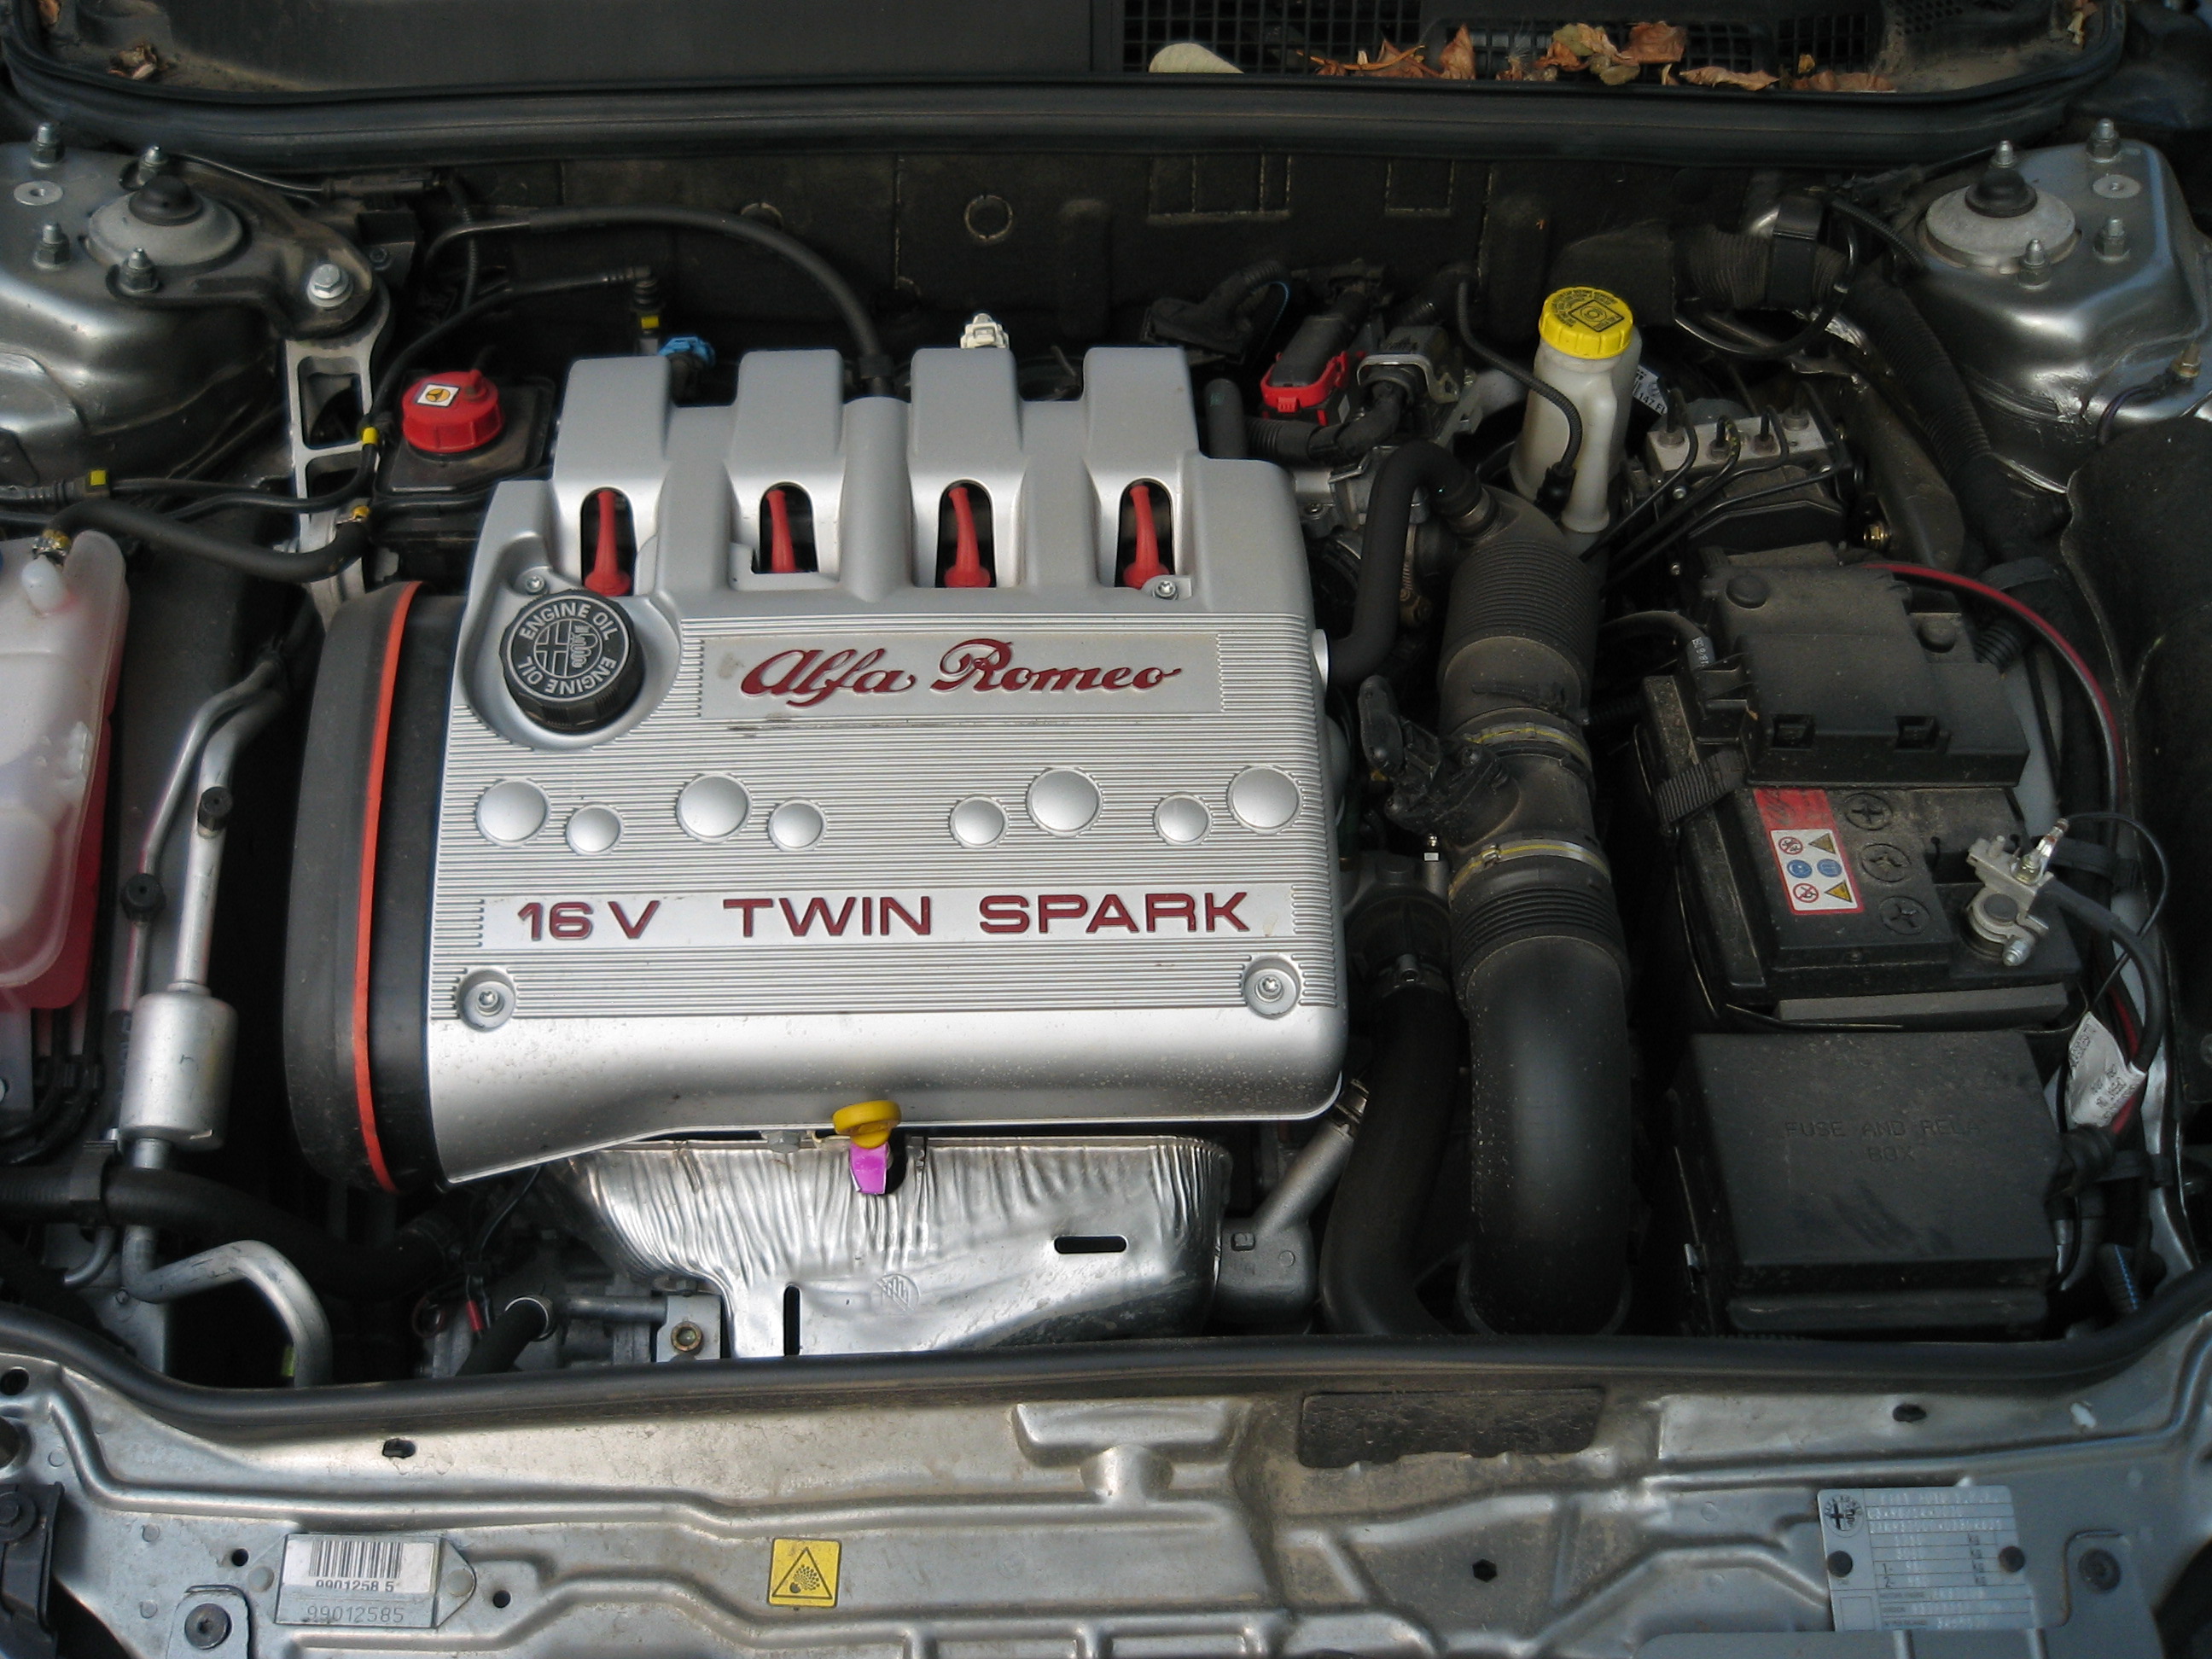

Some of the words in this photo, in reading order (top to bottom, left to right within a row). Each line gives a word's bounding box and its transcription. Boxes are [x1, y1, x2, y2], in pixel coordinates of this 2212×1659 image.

[520, 602, 591, 640] ENGINE
[593, 612, 619, 641] OIL
[518, 655, 544, 685] OIL
[544, 656, 617, 695] ENGINE
[740, 648, 917, 708] Alfa
[929, 638, 1182, 693] Romeo
[517, 901, 594, 940] 16
[608, 899, 661, 940] V
[723, 896, 931, 937] TWIN
[980, 892, 1250, 934] SPARK
[1785, 1121, 1846, 1137] FUSE
[1861, 1120, 1906, 1136] AND
[1920, 1119, 1988, 1136] RELA
[1867, 1146, 1915, 1161] BOX
[307, 1605, 405, 1622] 99012585
